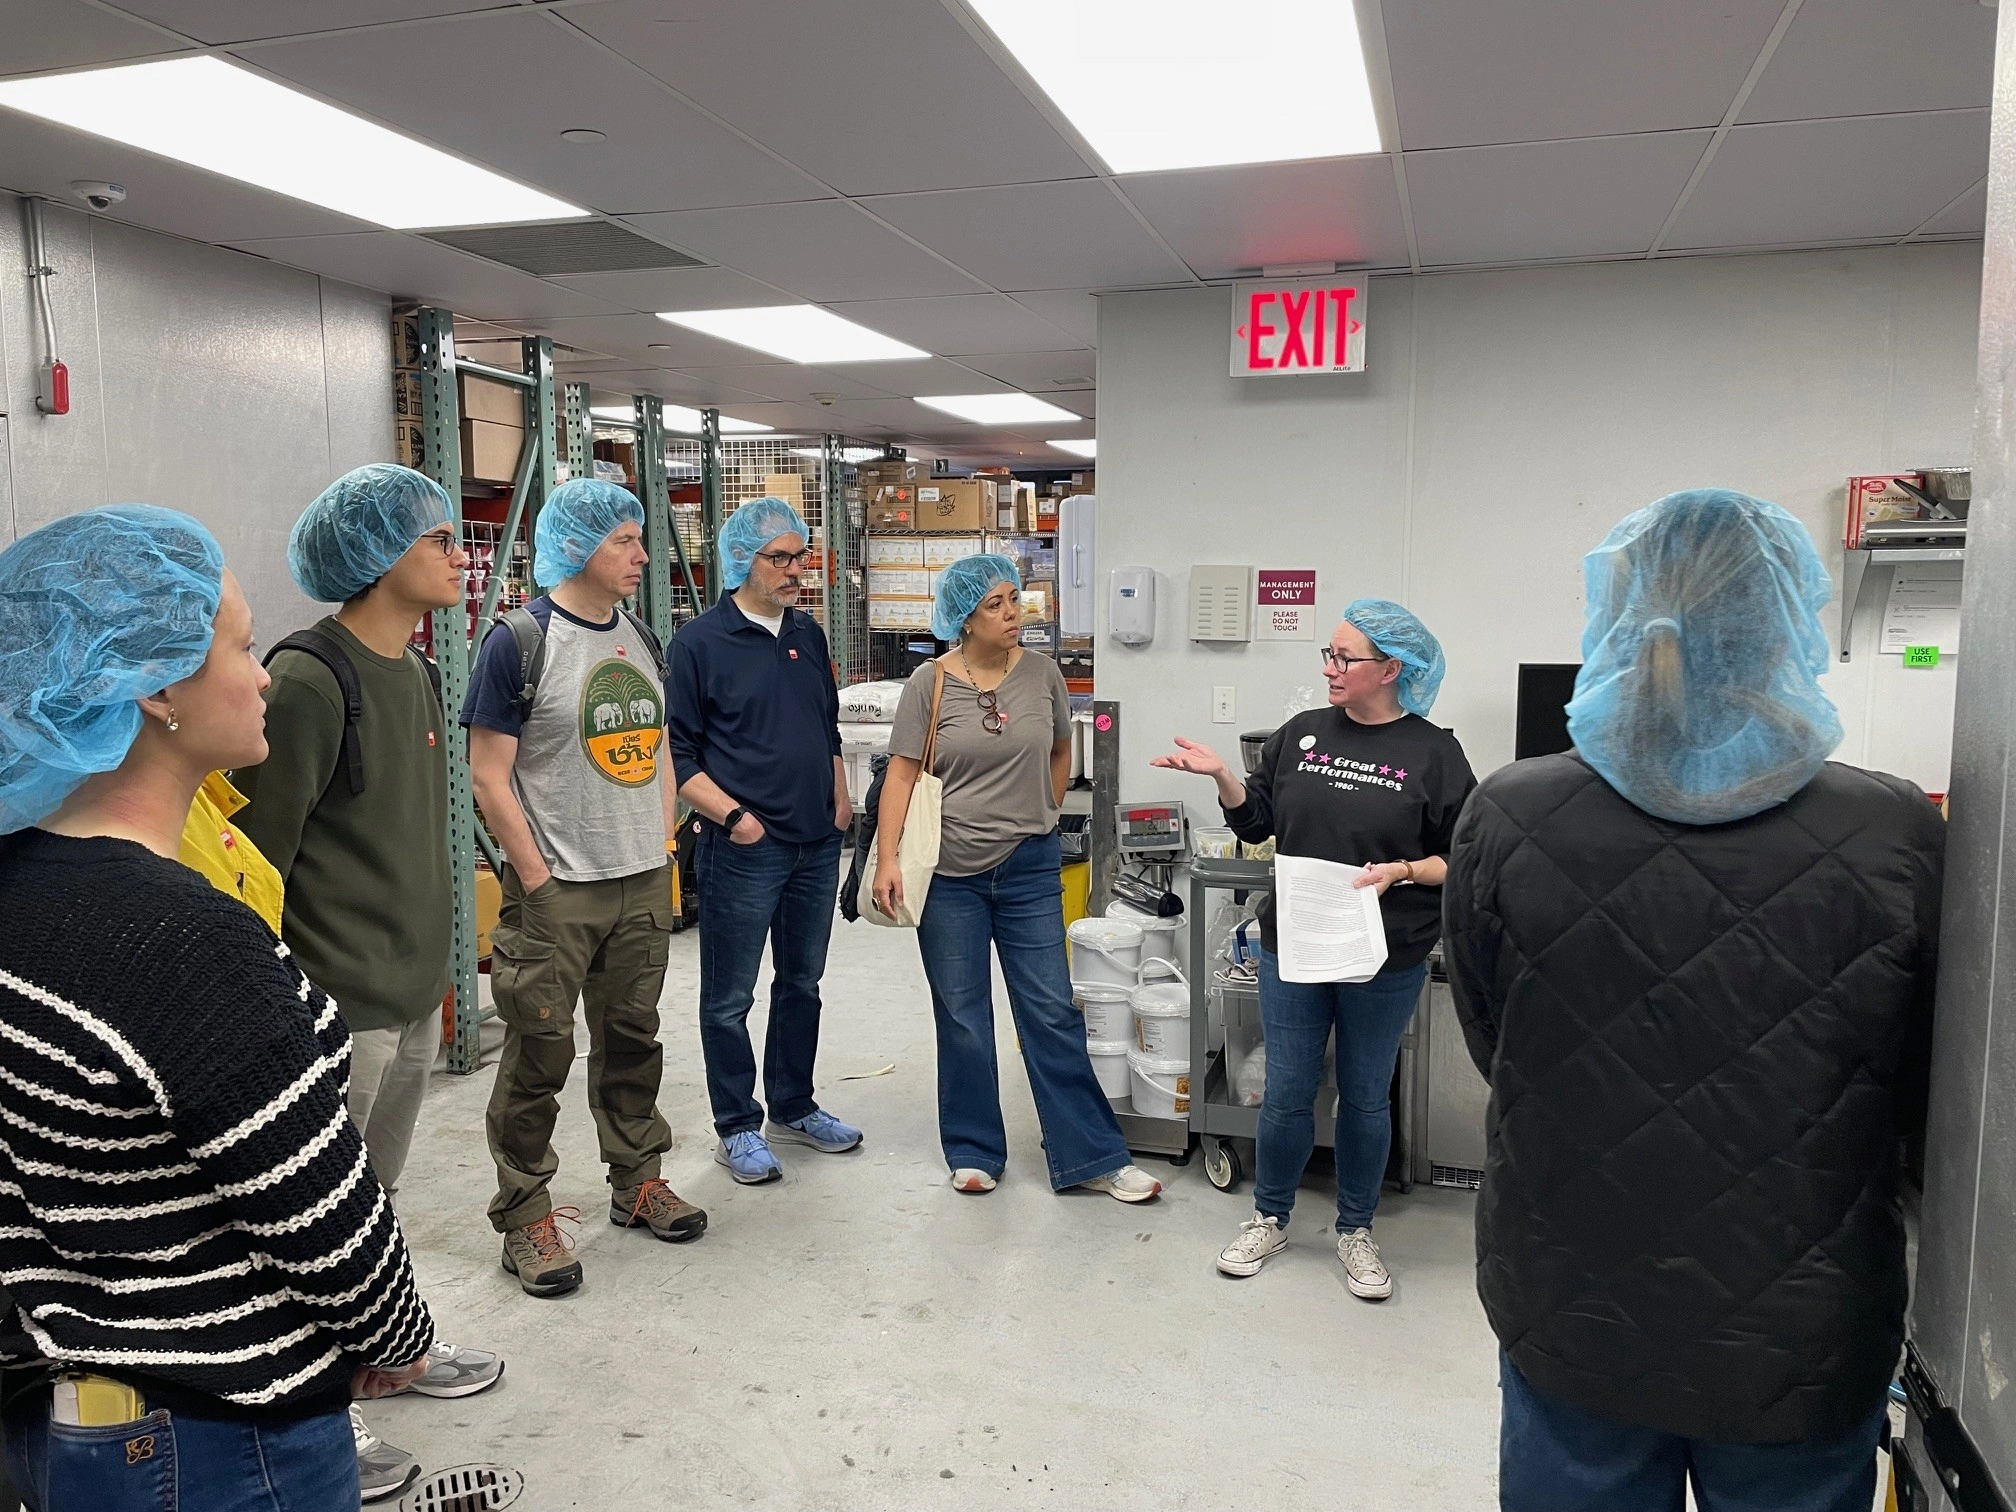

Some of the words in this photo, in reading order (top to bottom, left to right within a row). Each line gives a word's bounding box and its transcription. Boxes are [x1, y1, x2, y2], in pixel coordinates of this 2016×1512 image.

[1248, 288, 1356, 369] EXIT
[1869, 496, 1890, 504] Super
[1271, 589, 1301, 599] ONLY
[1333, 757, 1377, 772] Great
[1297, 761, 1403, 792] Performances
